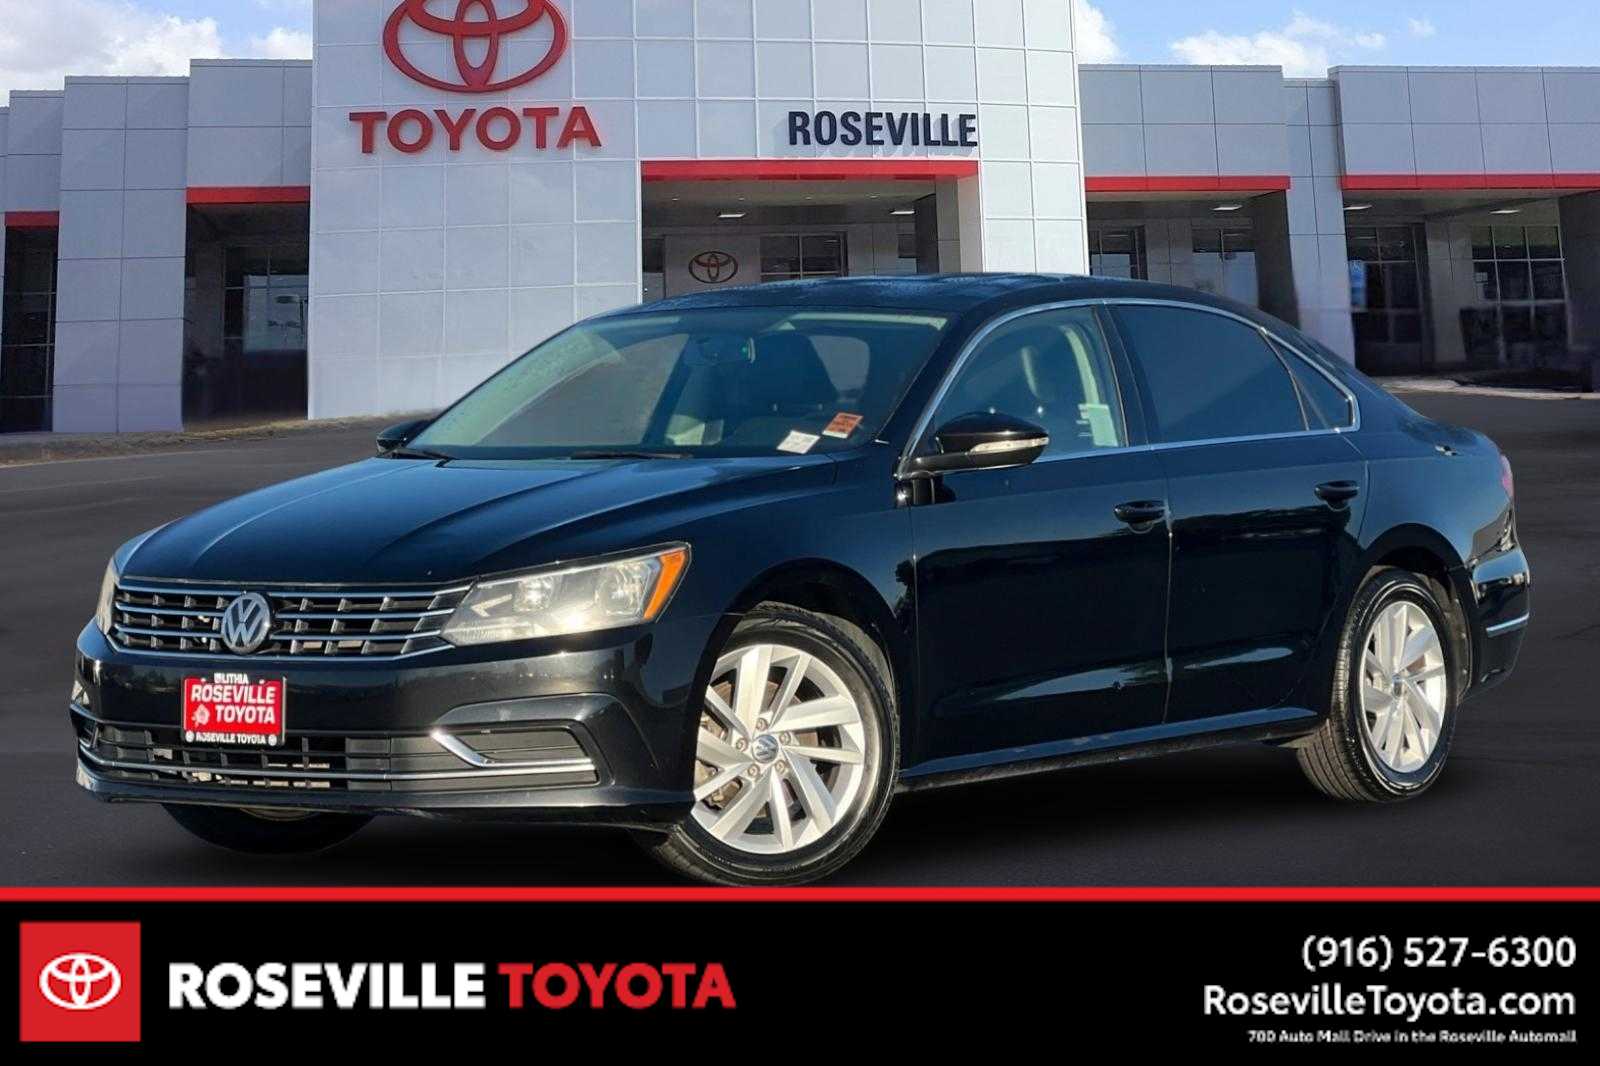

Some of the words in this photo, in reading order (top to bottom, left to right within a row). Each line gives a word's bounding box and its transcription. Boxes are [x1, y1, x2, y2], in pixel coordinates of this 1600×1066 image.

[349, 106, 602, 154] TOYOTA
[788, 110, 978, 148] ROSEVILLE
[190, 684, 276, 704] ROSEVILLE
[214, 705, 276, 724] TOYOTA
[196, 732, 235, 743] ROSEVILLE
[237, 734, 266, 745] TOYOTA
